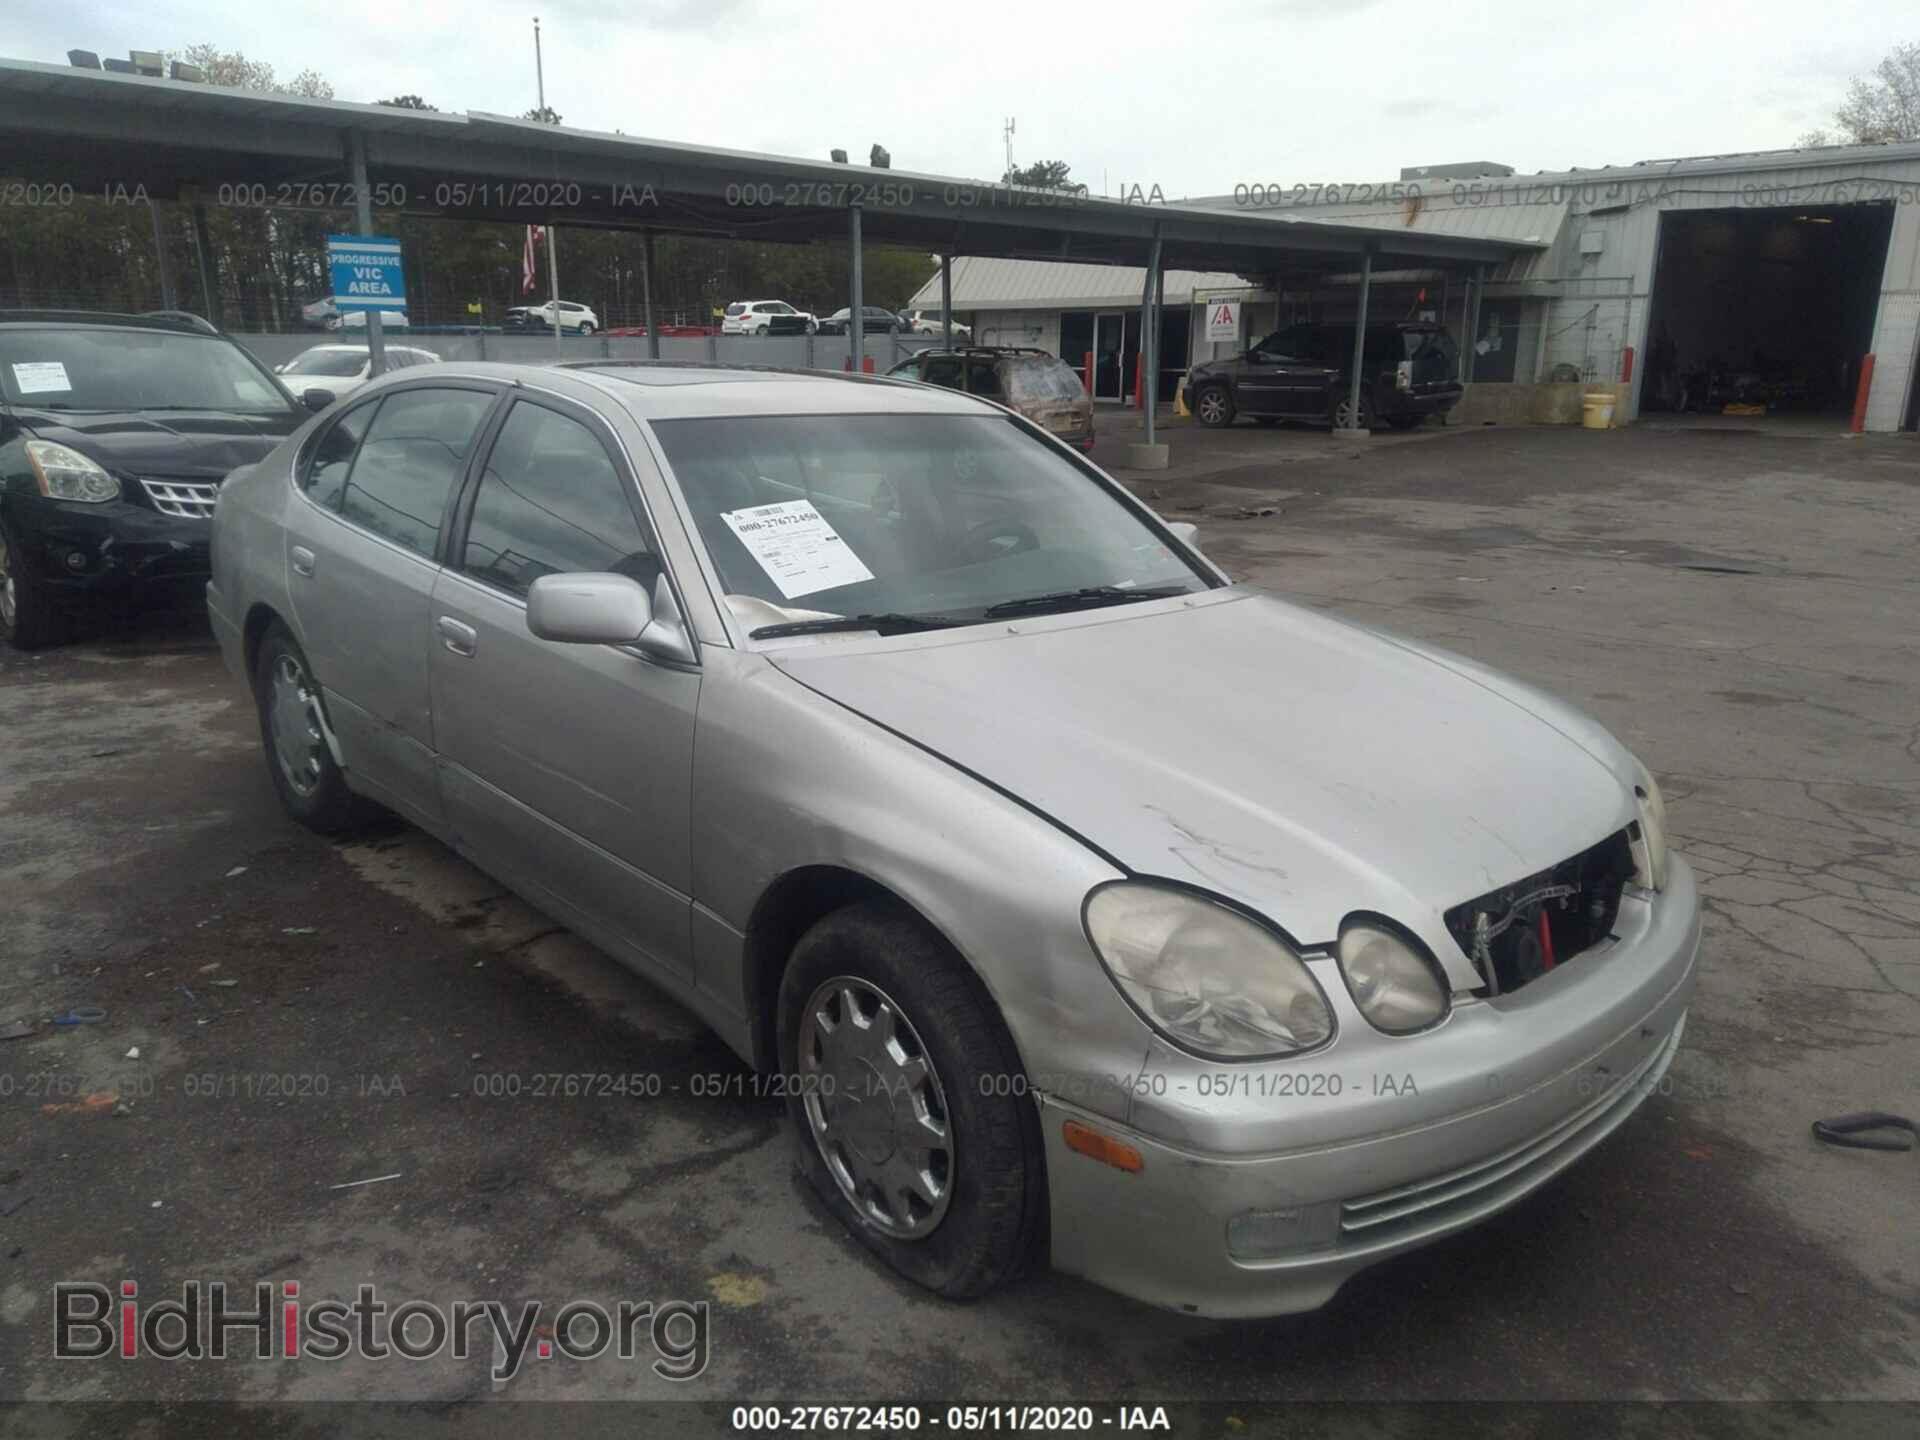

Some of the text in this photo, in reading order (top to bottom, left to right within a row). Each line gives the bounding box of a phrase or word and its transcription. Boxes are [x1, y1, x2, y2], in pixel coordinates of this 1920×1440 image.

[331, 253, 401, 267] PROGRESSIVE
[353, 267, 383, 280] VIC
[348, 281, 392, 295] AREA
